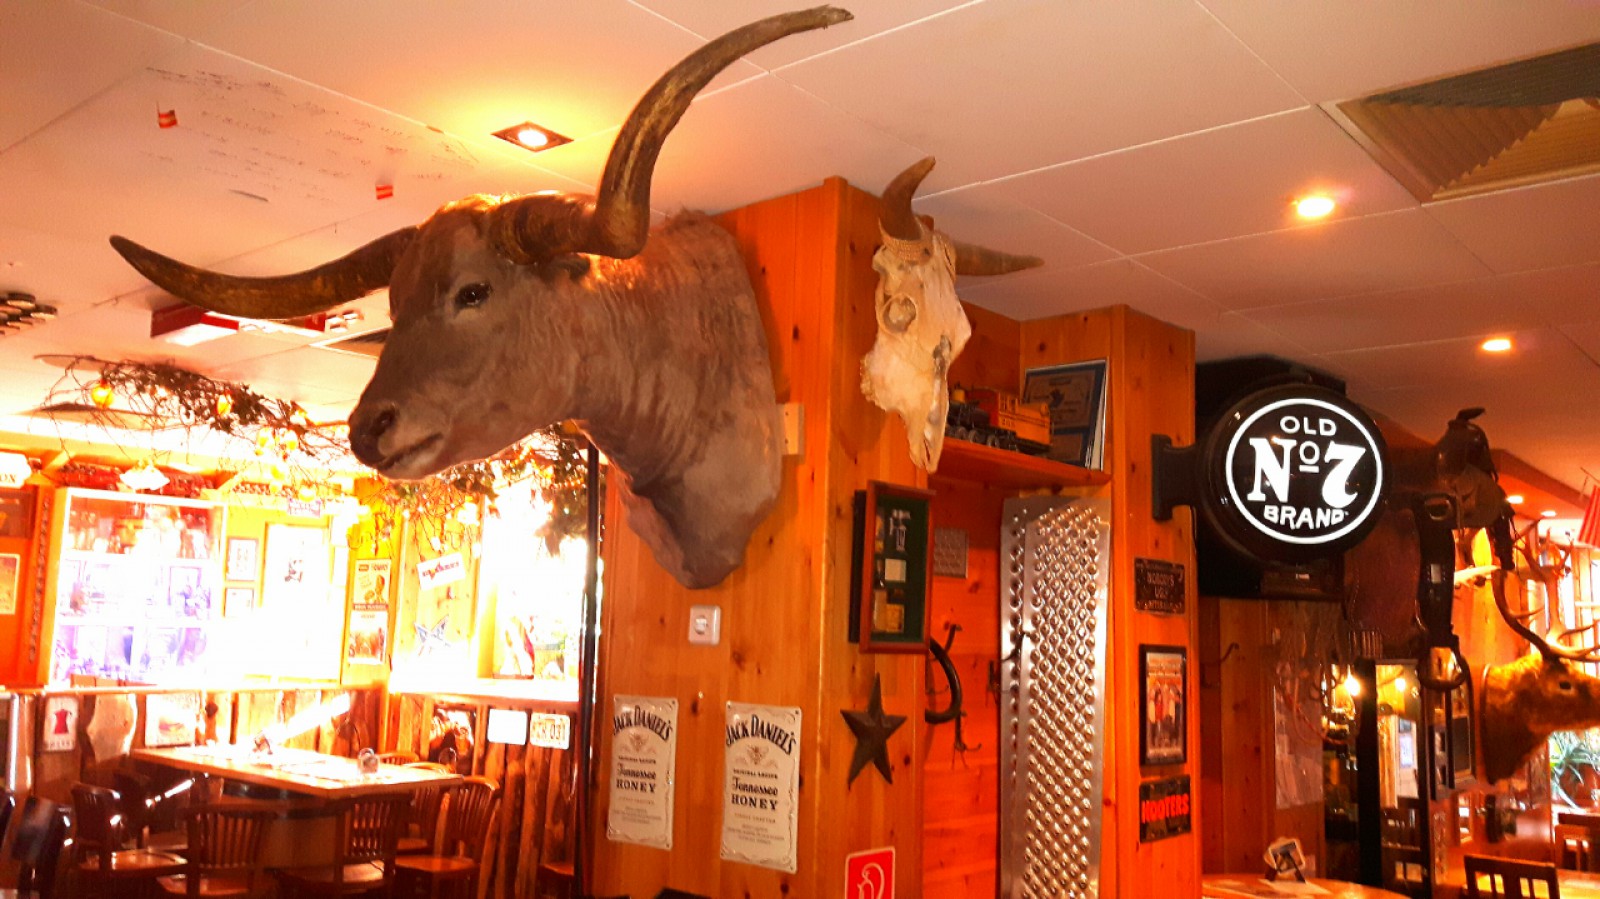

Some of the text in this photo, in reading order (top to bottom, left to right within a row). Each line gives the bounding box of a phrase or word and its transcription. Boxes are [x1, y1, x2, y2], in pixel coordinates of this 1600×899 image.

[1280, 415, 1337, 437] OLD
[1264, 504, 1345, 530] BRAND
[613, 704, 673, 743] JACK DANIEL'S
[725, 713, 797, 756] JACK DANIEL'S
[616, 778, 656, 793] HONEY
[731, 775, 778, 796] Tennessee
[731, 793, 777, 811] HONEY
[1141, 793, 1189, 824] HOOTERS
